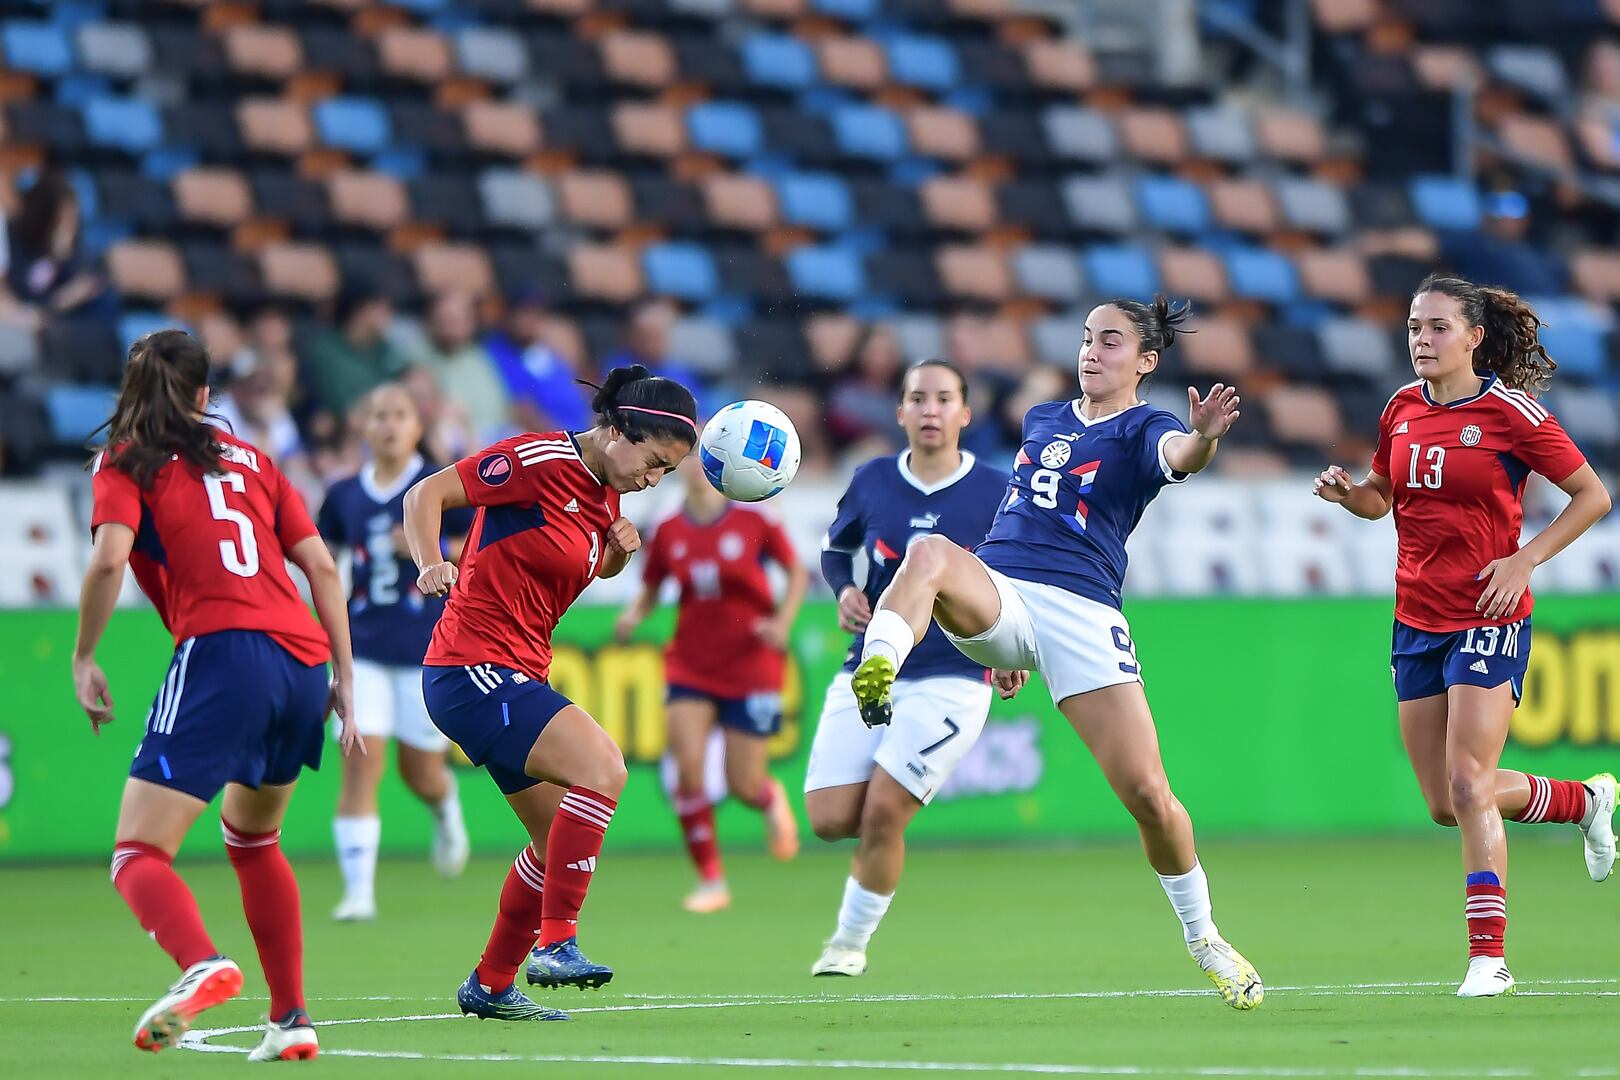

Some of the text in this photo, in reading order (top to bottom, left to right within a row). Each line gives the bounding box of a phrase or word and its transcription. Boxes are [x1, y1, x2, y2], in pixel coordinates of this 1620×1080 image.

[1030, 468, 1063, 510] 9
[1406, 443, 1446, 489] 13
[202, 469, 260, 578] 5
[587, 530, 599, 579] 4
[1110, 625, 1138, 676] 9
[1459, 626, 1501, 657] 13
[918, 716, 961, 758] 7
